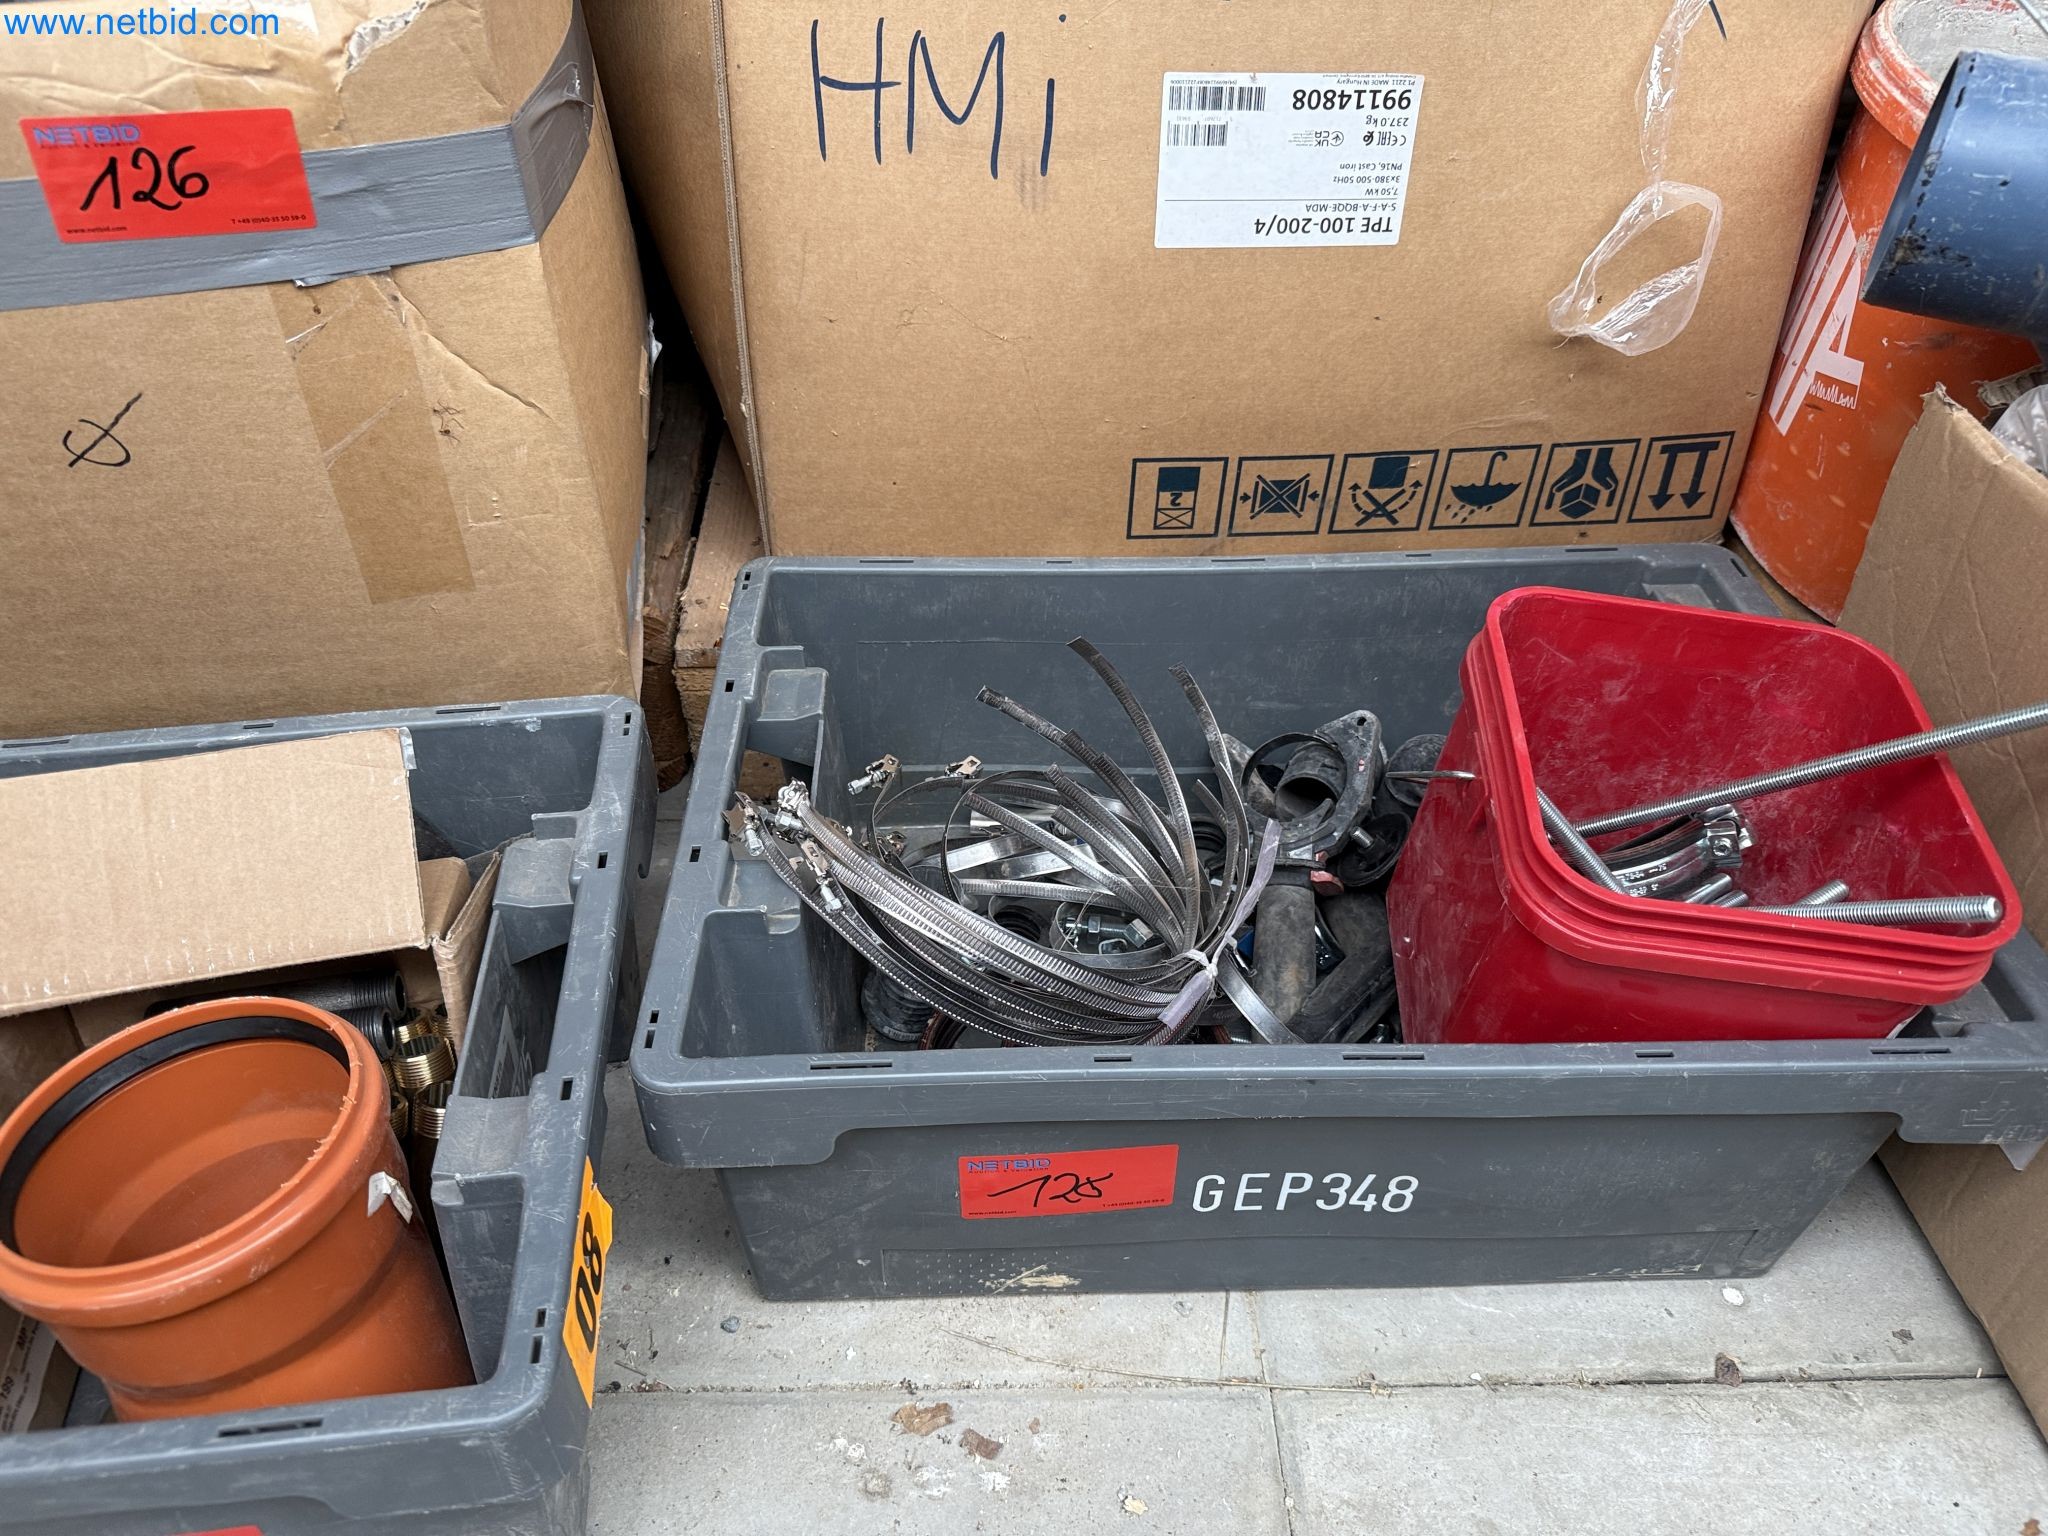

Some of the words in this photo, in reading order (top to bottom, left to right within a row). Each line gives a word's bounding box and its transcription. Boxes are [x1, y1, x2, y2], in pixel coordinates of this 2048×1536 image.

[1336, 78, 1362, 86] Hungary
[1292, 89, 1412, 110] 99114808
[1366, 114, 1378, 127] kg
[1380, 116, 1409, 127] 237.0
[34, 123, 141, 145] NETBID
[1339, 162, 1357, 172] iron
[1358, 162, 1376, 171] Cast
[80, 145, 209, 212] 126
[1333, 175, 1354, 184] 50Hz
[1356, 175, 1401, 184] 3x380-500
[1365, 187, 1379, 196] kW
[1381, 187, 1398, 196] 7,50
[1305, 202, 1397, 213] S-A-F-A-BQQE-MDA
[1254, 214, 1355, 236] 100-200/4
[1360, 216, 1393, 233] TPE
[967, 1158, 1051, 1171] NETBID
[987, 1173, 1113, 1208] 125
[1191, 1171, 1419, 1213] GEP348
[575, 1211, 602, 1354] 80
